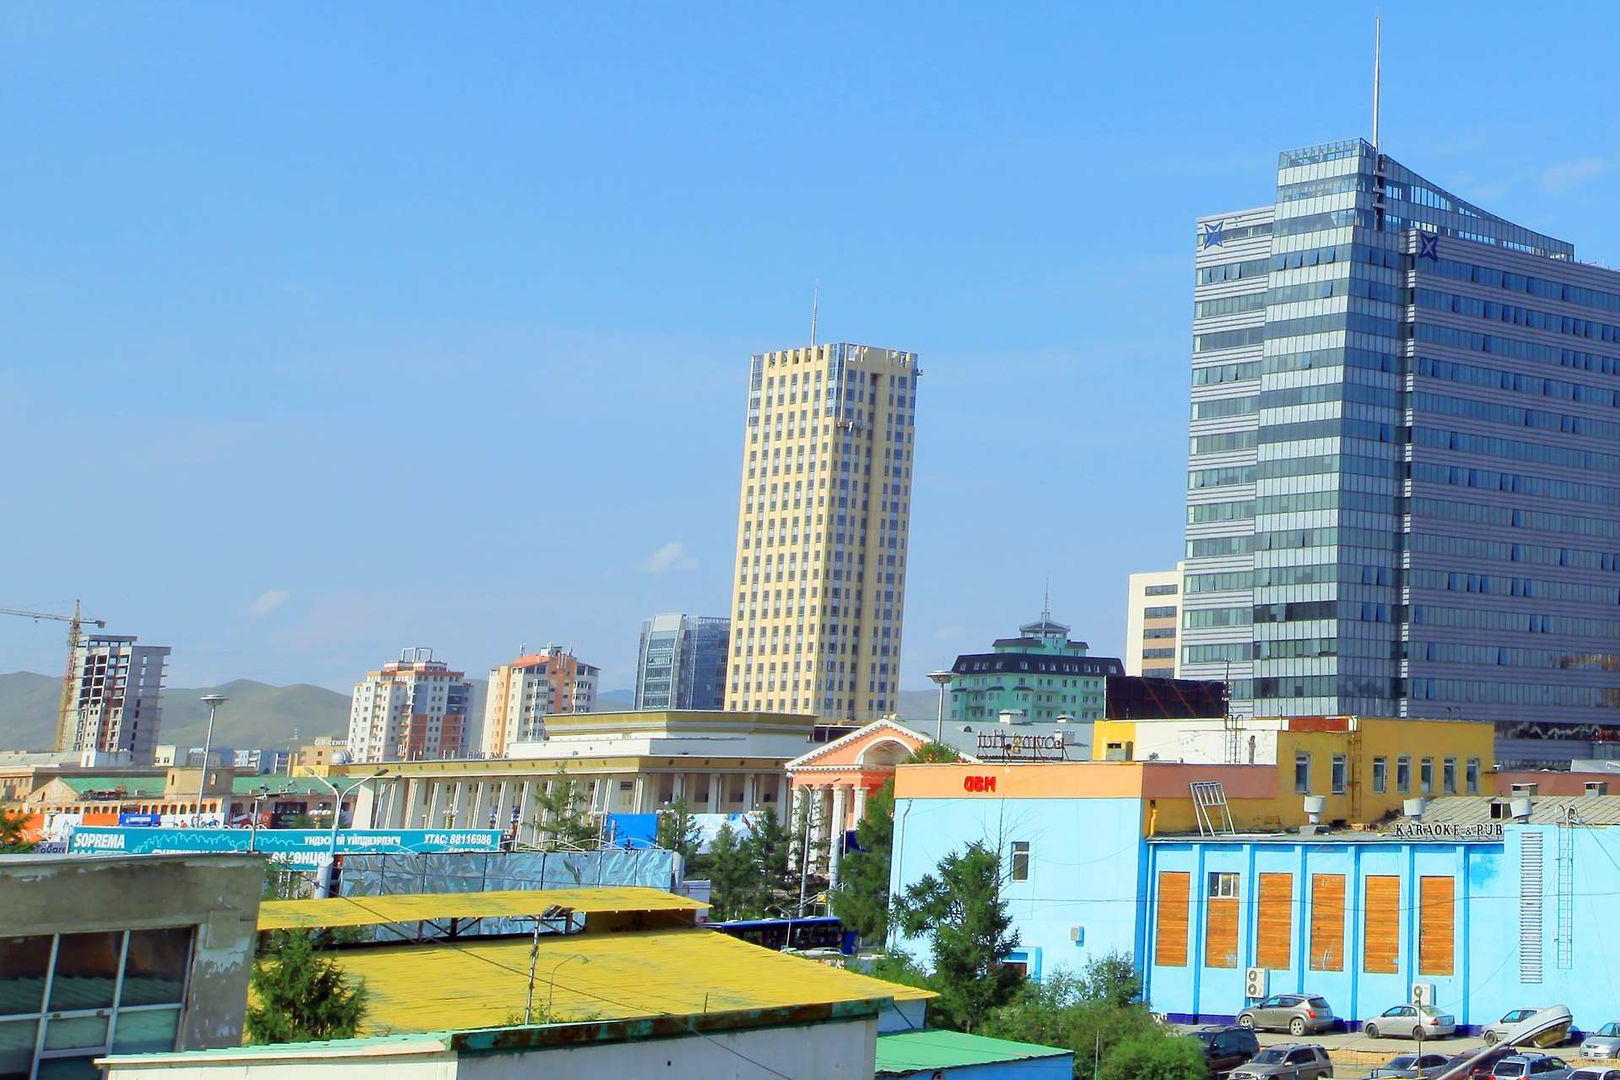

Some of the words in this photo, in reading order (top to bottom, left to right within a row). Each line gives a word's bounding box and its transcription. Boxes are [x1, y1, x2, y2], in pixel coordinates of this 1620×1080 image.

[1396, 824, 1460, 836] KARAOKE
[1465, 826, 1472, 836] &
[1477, 824, 1503, 836] PUB
[74, 833, 125, 849] SOPREMA
[450, 834, 492, 846] 88116986
